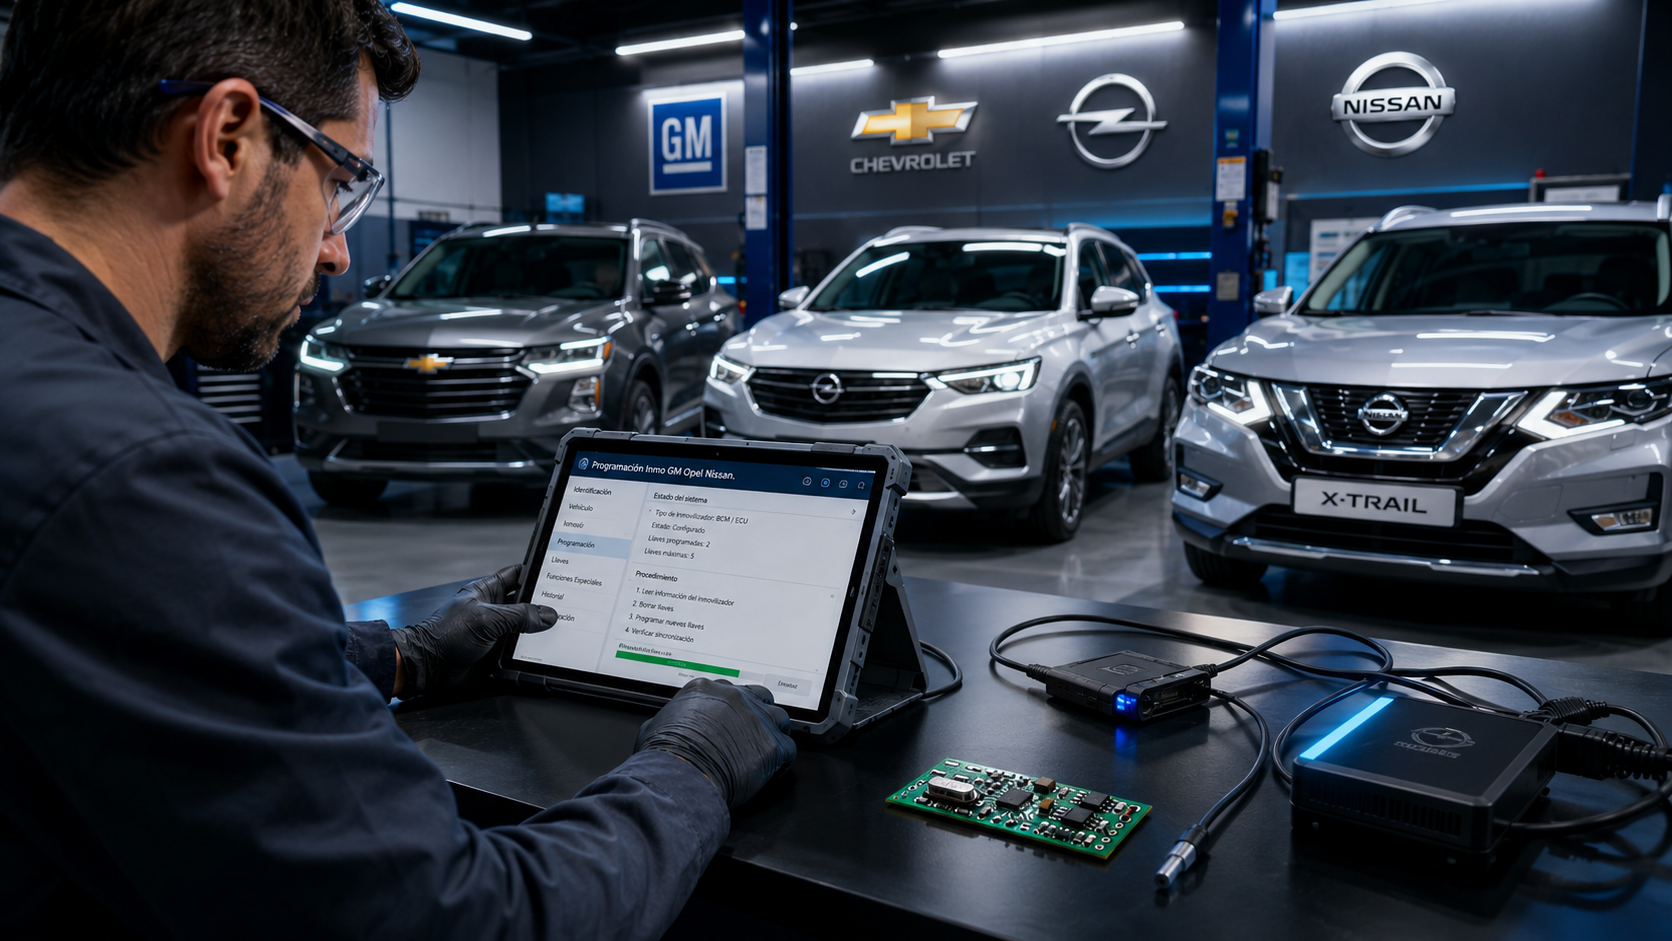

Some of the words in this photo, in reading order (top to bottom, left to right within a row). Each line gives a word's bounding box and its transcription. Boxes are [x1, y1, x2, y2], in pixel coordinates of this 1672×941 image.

[1344, 94, 1442, 115] NISSAN
[661, 114, 712, 162] GM
[850, 150, 977, 174] CHEVROLET
[591, 460, 644, 473] Programación
[645, 464, 666, 475] Inmo
[667, 466, 682, 476] GM
[683, 467, 704, 479] Opel
[653, 492, 674, 501] Estado
[684, 496, 708, 504] sistema
[1321, 491, 1428, 514] X-TRAIL
[568, 503, 594, 512] Vehículo
[557, 537, 596, 549] Programación
[551, 556, 570, 565] Llaves
[546, 572, 573, 583] Funciones
[573, 576, 603, 587] Especiales
[635, 570, 678, 583] Procedimiento
[541, 590, 565, 600] Historial
[641, 587, 655, 595] Leer
[655, 589, 687, 600] información
[687, 594, 698, 602] del
[638, 600, 657, 610] Borrar
[635, 613, 665, 624] Programar
[631, 627, 655, 638] Verificar
[655, 631, 695, 644] sincronización
